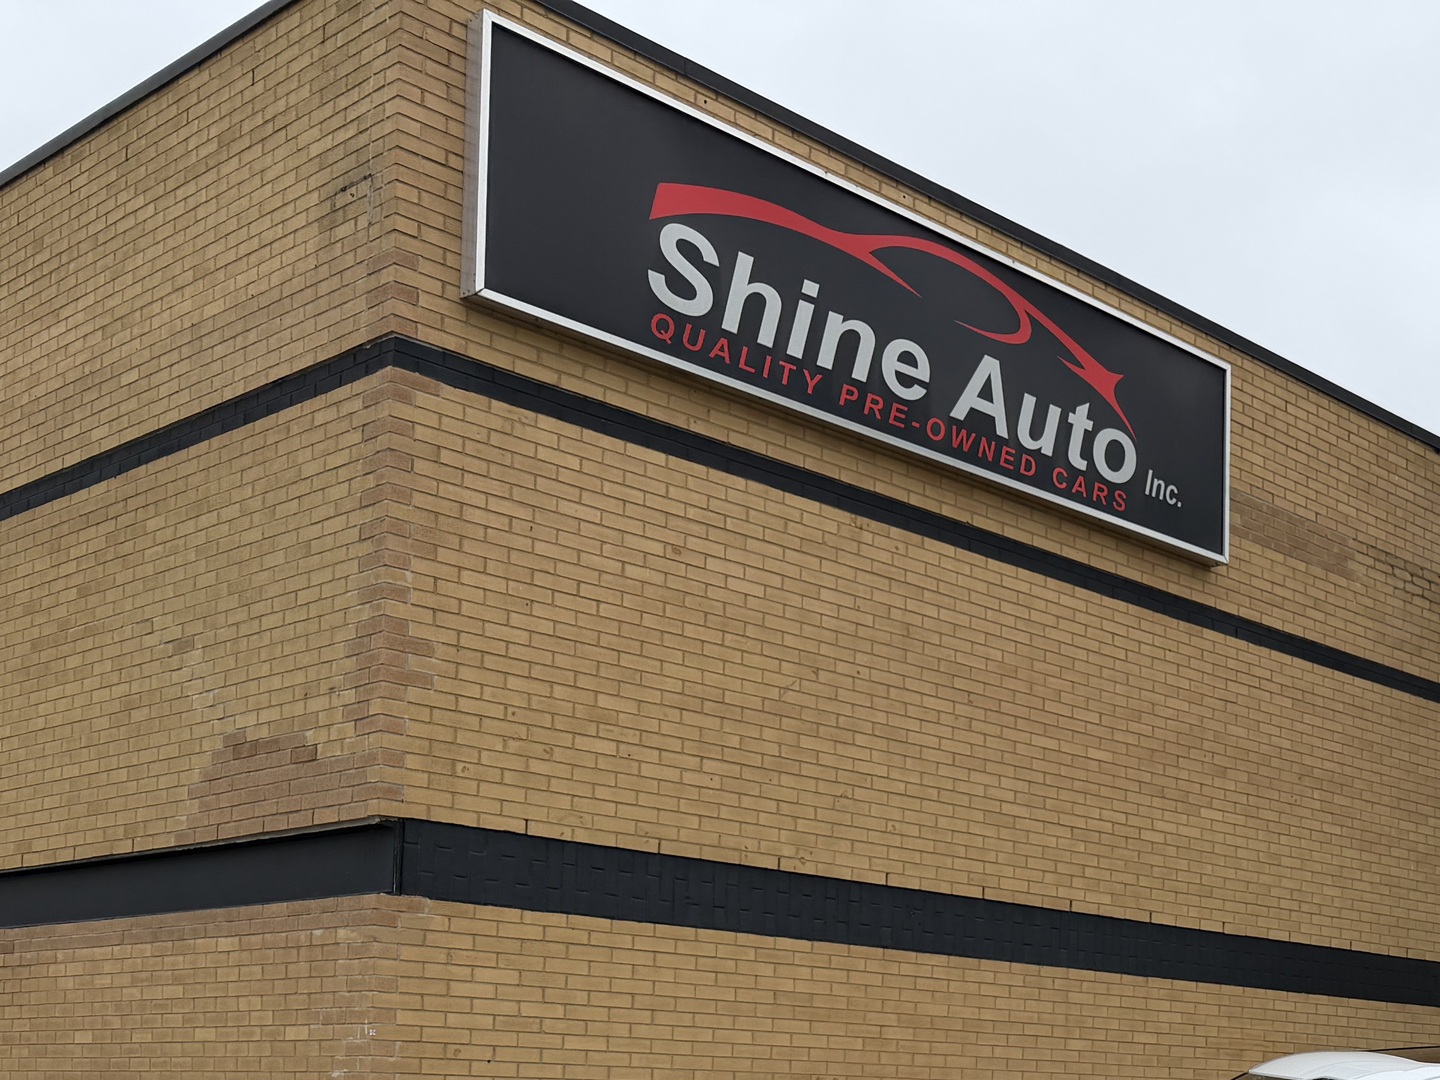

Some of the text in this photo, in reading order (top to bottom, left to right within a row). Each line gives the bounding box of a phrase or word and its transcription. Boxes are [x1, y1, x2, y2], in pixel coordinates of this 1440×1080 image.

[648, 223, 1182, 508] Shine Auto Inc.
[651, 313, 1127, 512] QUALITY PRE-OWNED CARS
